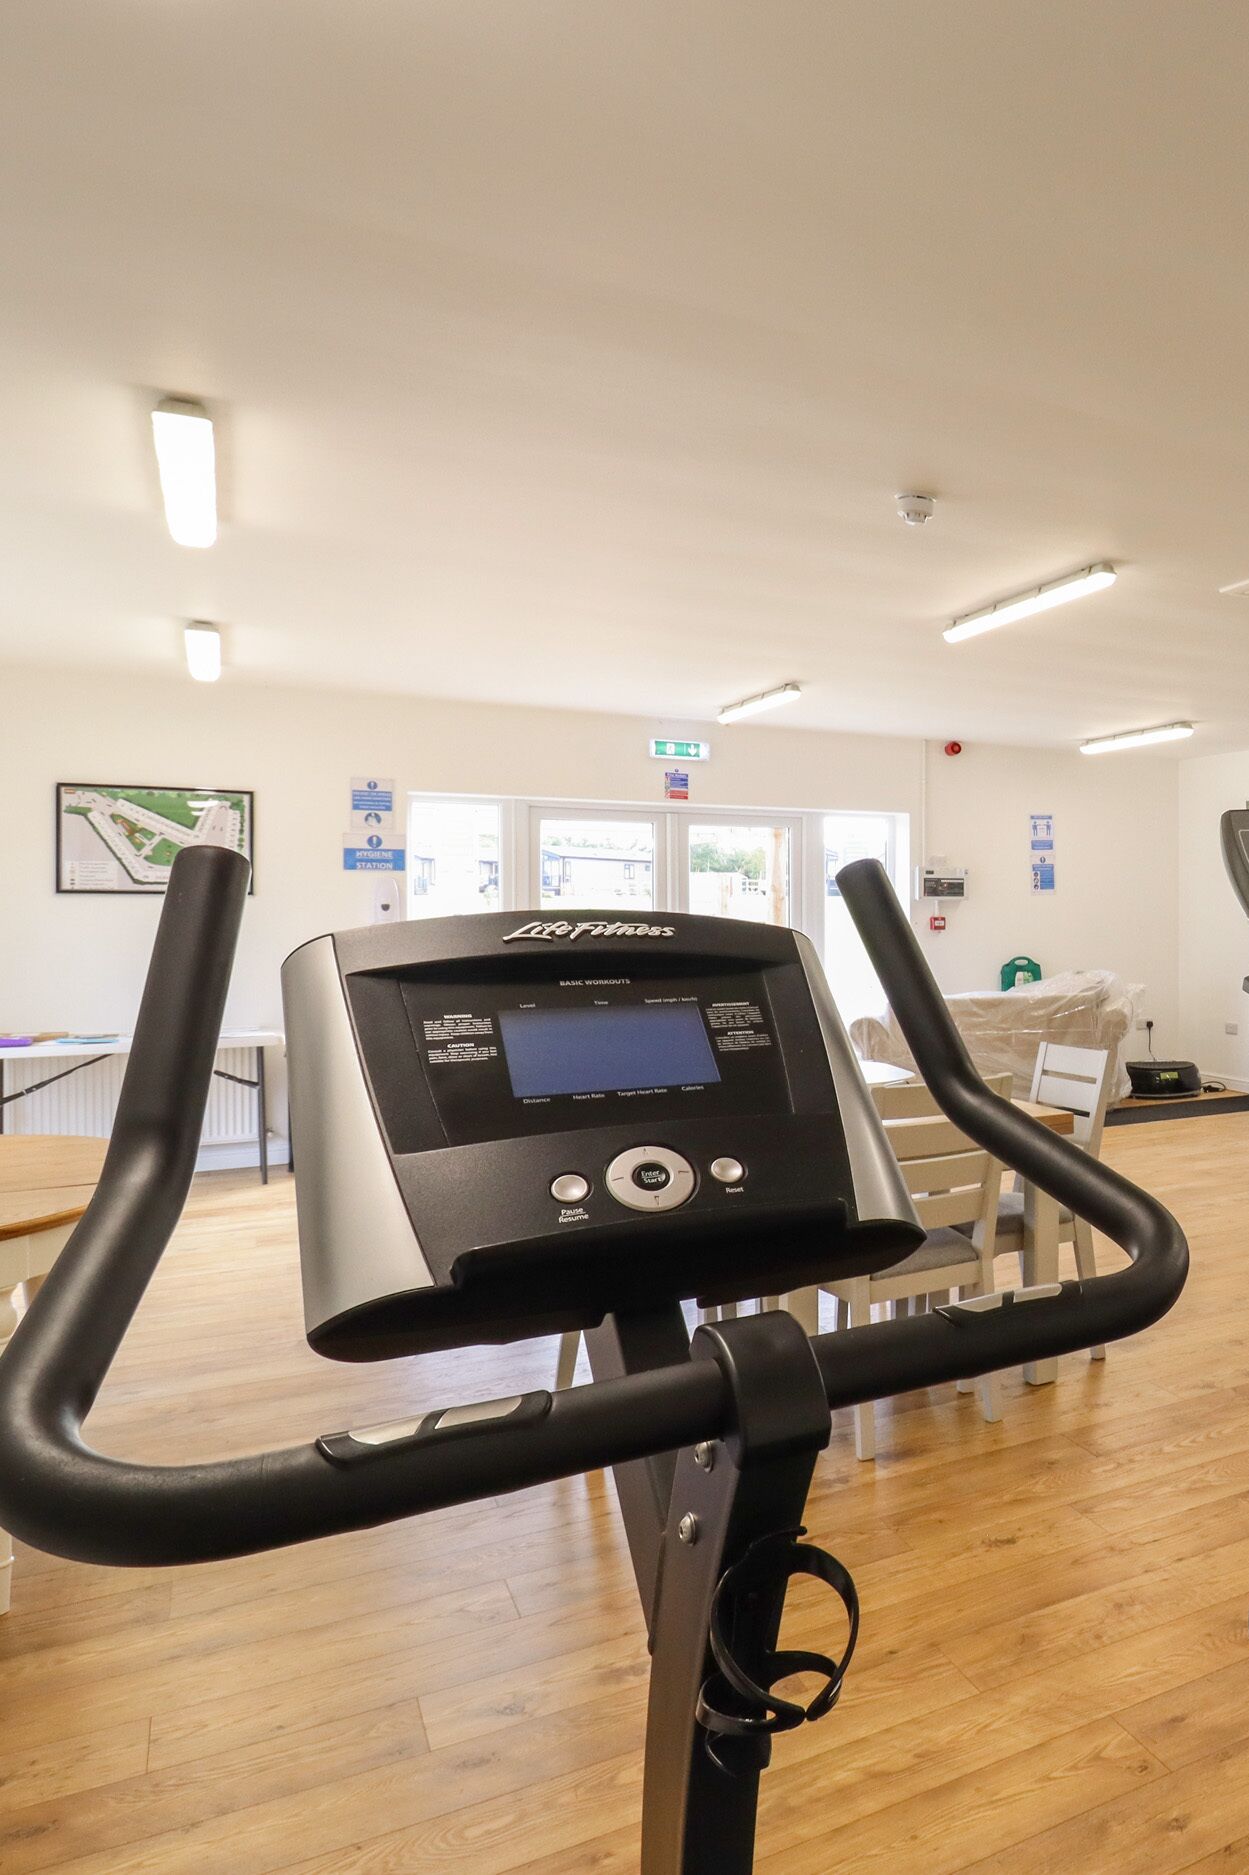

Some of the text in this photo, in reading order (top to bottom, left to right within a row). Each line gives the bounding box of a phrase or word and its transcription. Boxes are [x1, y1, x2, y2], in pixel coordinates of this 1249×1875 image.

[356, 850, 393, 859] HYGIENE
[356, 862, 393, 870] STATION
[584, 978, 632, 987] WORKOUTS
[617, 1090, 637, 1098] Target
[523, 1097, 551, 1105] Distance
[641, 1169, 661, 1178] Enter
[643, 1175, 663, 1184] Start
[725, 1186, 745, 1194] Reset
[561, 1207, 584, 1216] Pause
[558, 1213, 590, 1224] Resume
